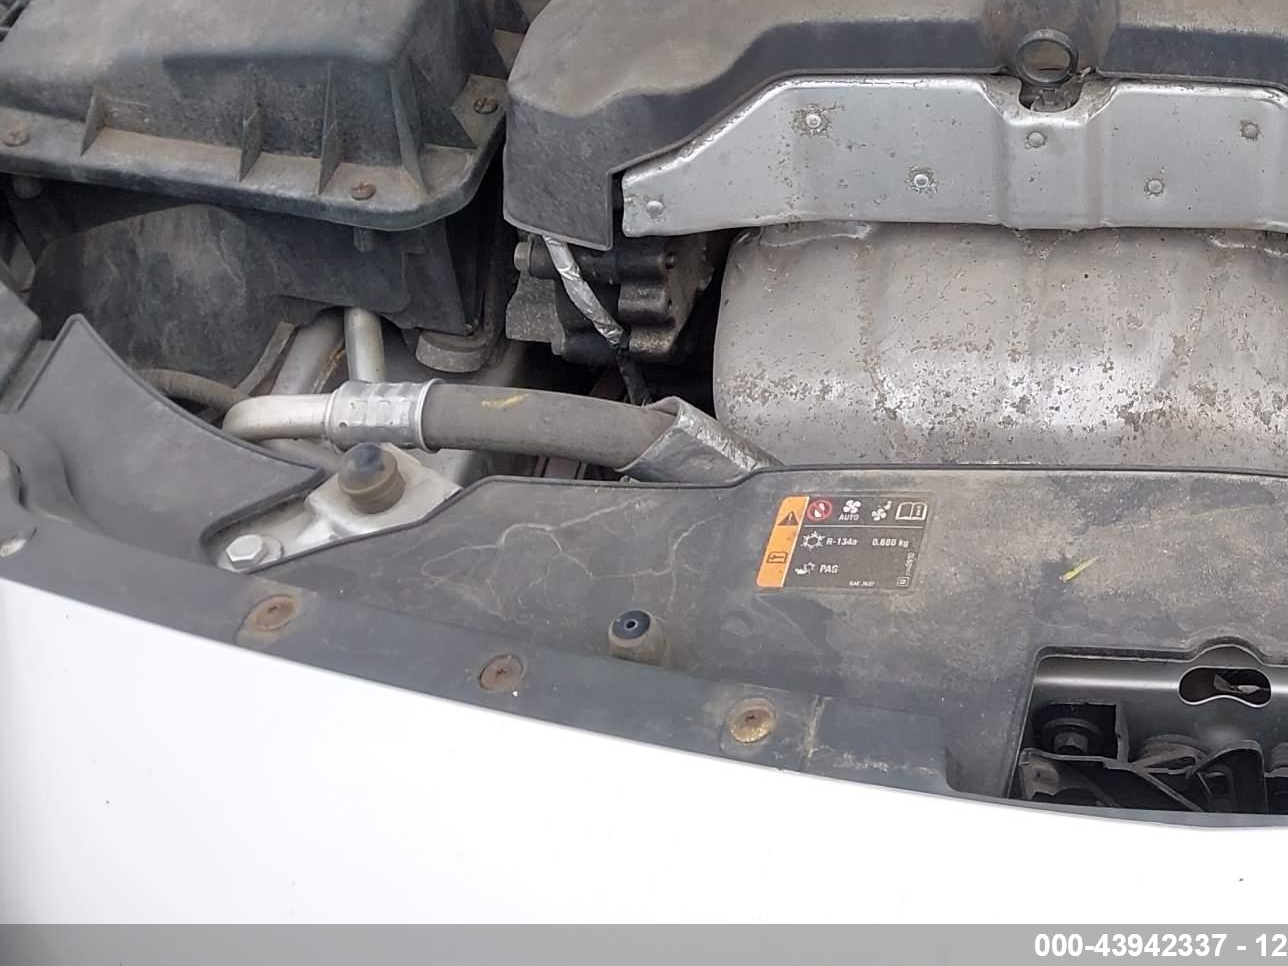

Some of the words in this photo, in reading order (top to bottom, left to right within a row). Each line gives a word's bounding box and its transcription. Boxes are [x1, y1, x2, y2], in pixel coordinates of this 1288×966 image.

[838, 513, 860, 521] AUTO
[825, 538, 858, 546] R-134a
[898, 538, 909, 548] kg
[819, 564, 839, 574] PAG
